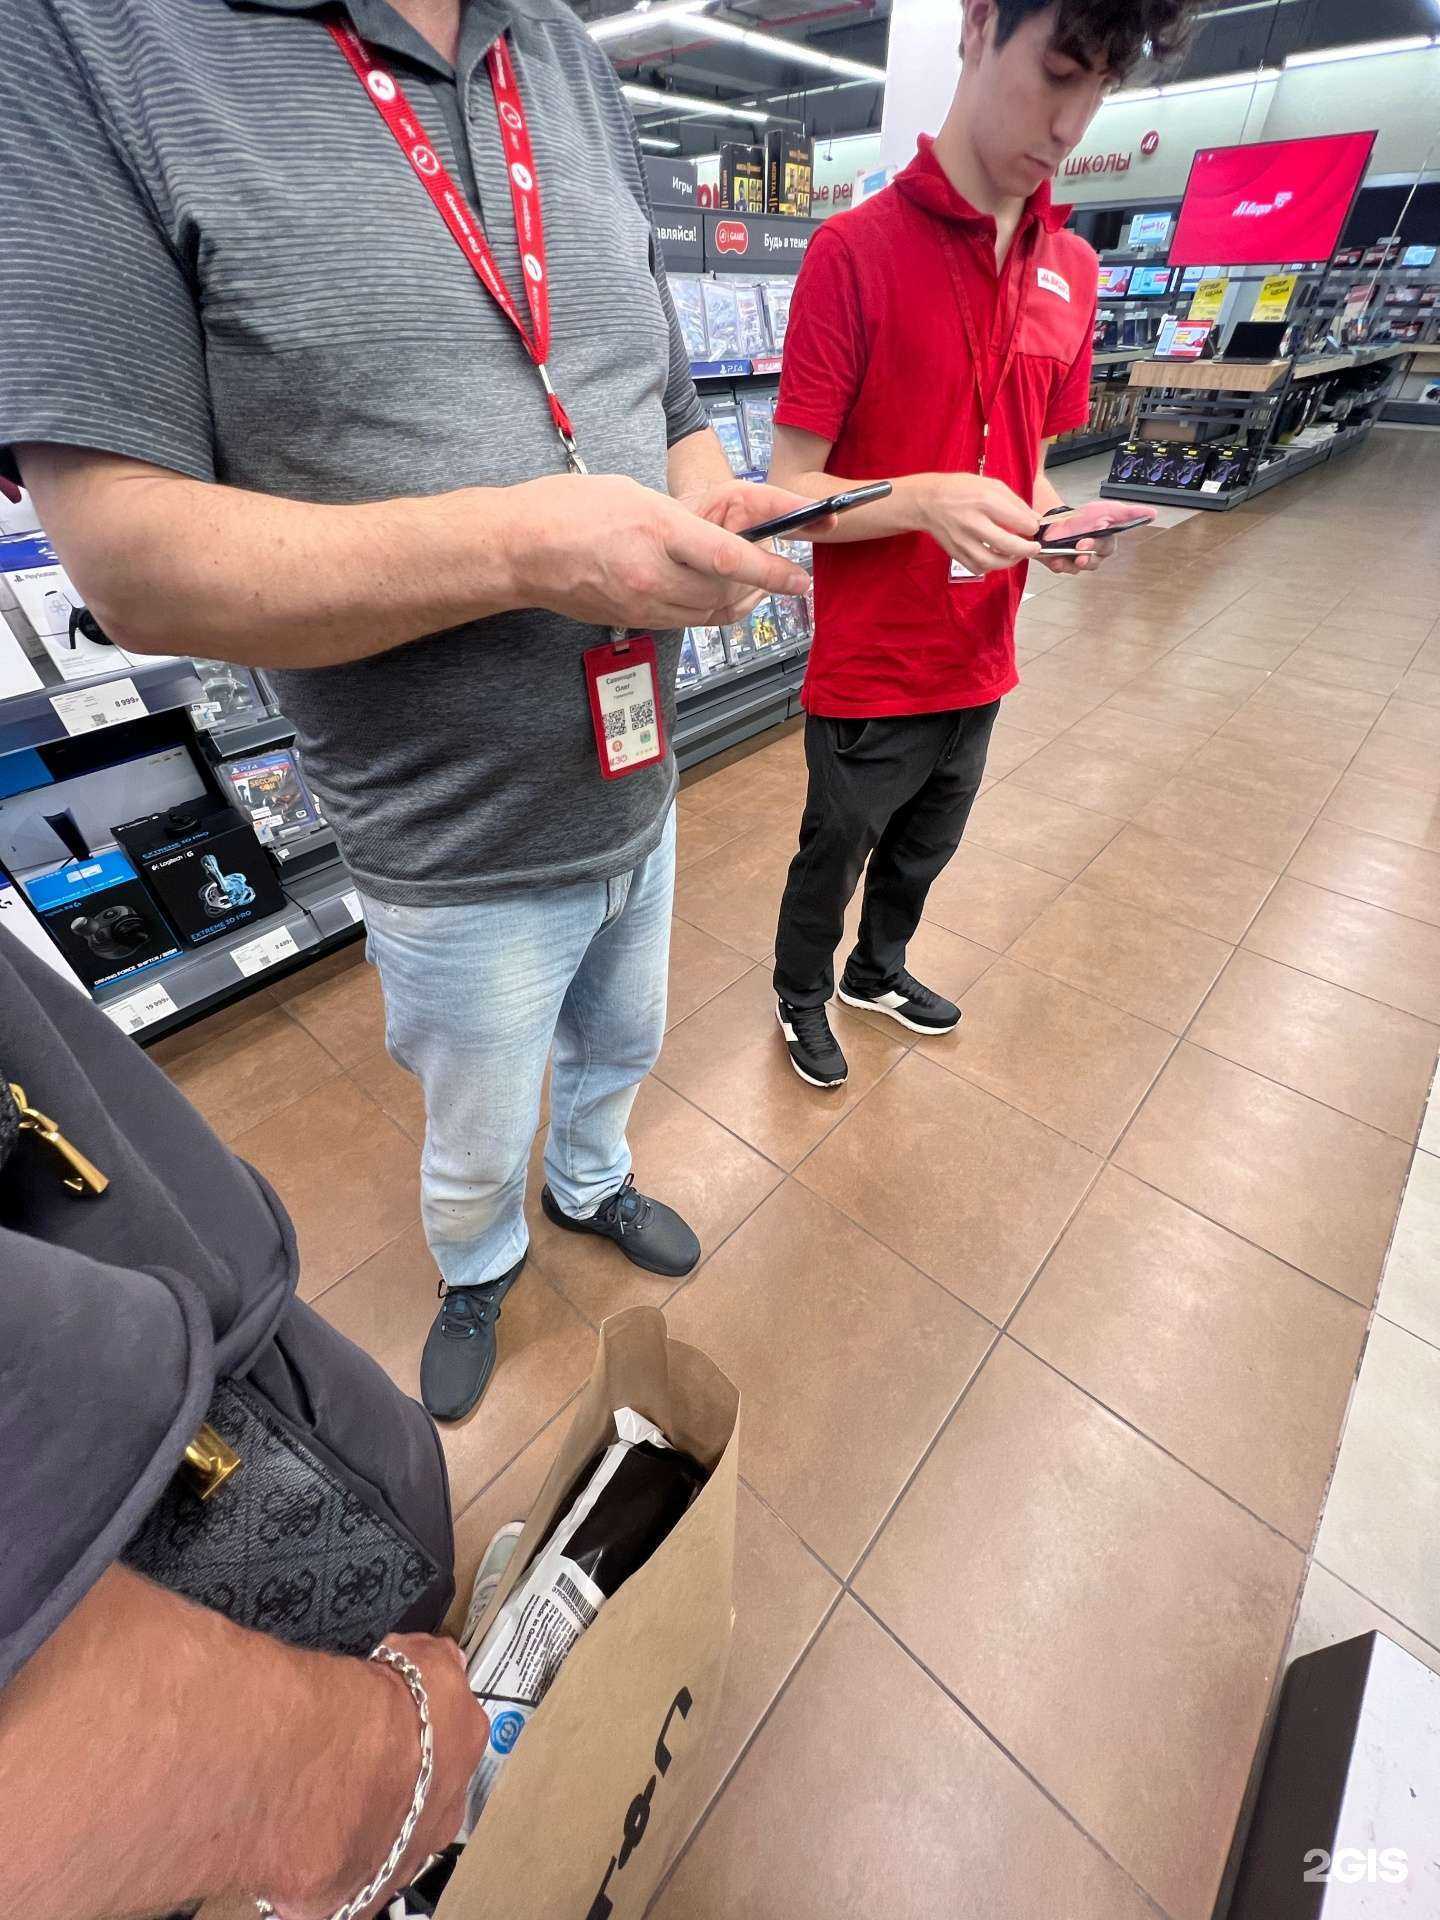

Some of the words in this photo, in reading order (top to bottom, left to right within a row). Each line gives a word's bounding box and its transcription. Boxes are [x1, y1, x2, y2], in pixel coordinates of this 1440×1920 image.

[672, 175, 692, 195] Игры
[764, 233, 783, 251] Будь
[784, 237, 789, 248] в
[790, 238, 808, 249] теме
[192, 922, 226, 941] EXTREME
[537, 1598, 551, 1618] Made
